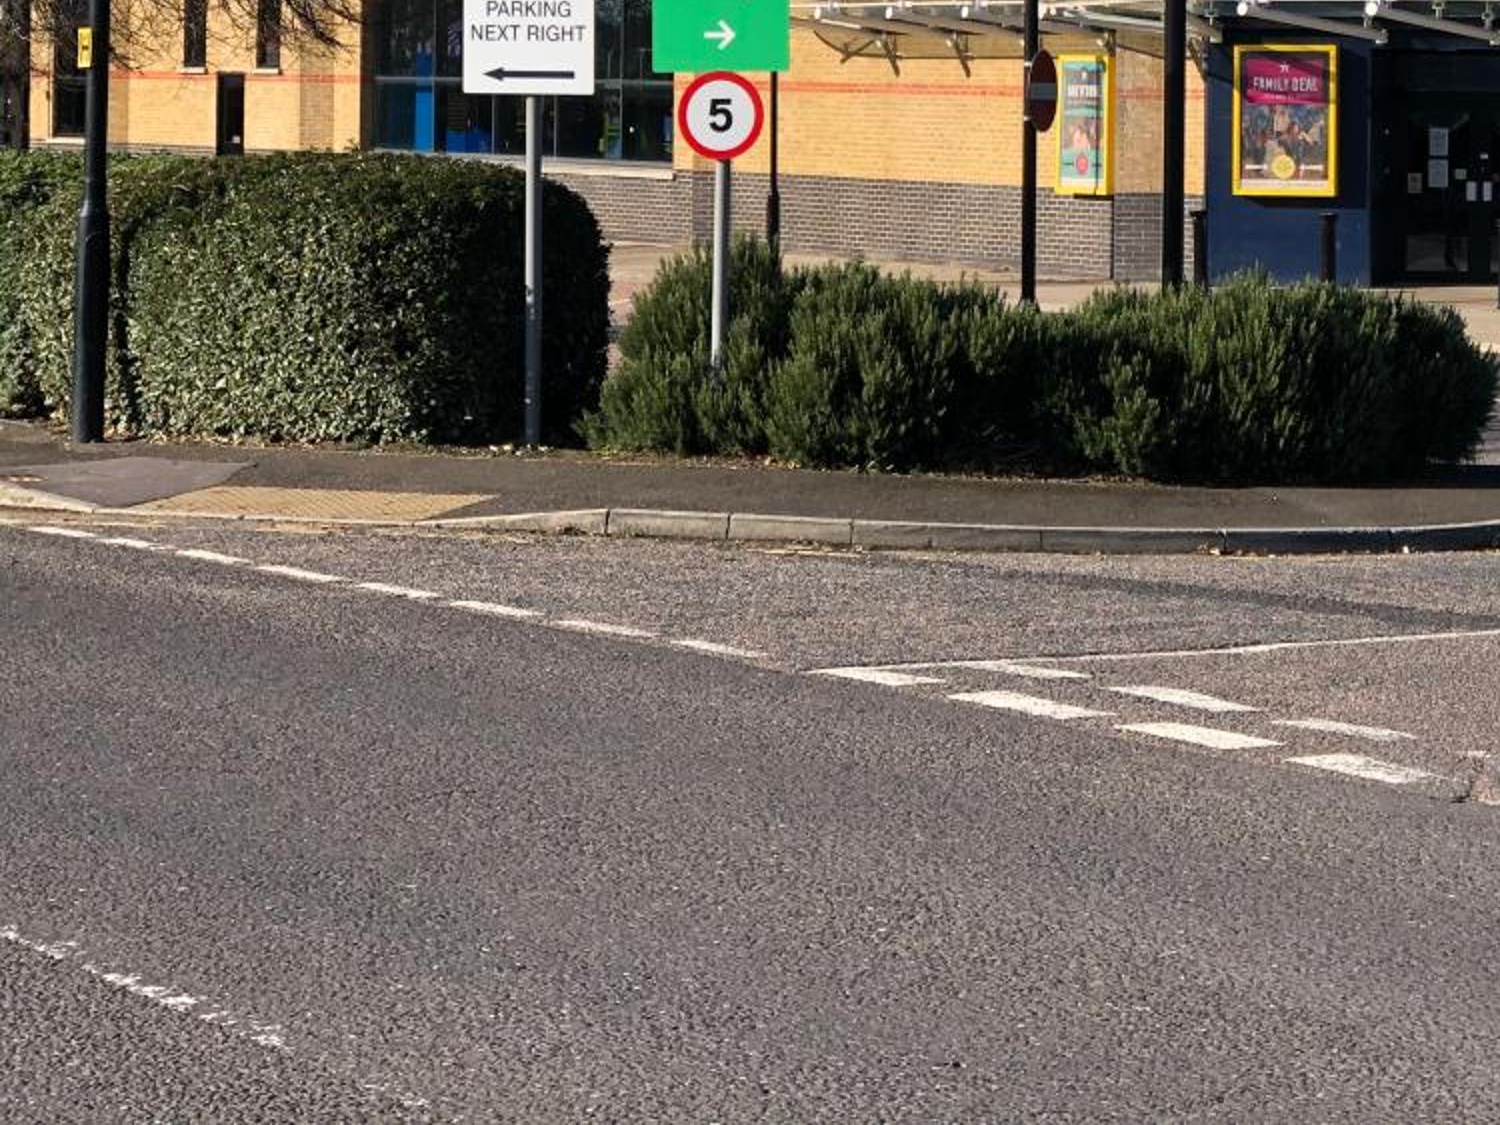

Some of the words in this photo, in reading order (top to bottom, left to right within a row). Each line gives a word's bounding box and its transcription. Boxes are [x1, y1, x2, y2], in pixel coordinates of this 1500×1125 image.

[485, 0, 572, 18] PARKING
[471, 24, 520, 42] NEXT
[527, 24, 586, 42] RIGHT
[1252, 76, 1289, 92] FAMILY
[1291, 76, 1319, 92] DEAL
[709, 98, 733, 133] 5
